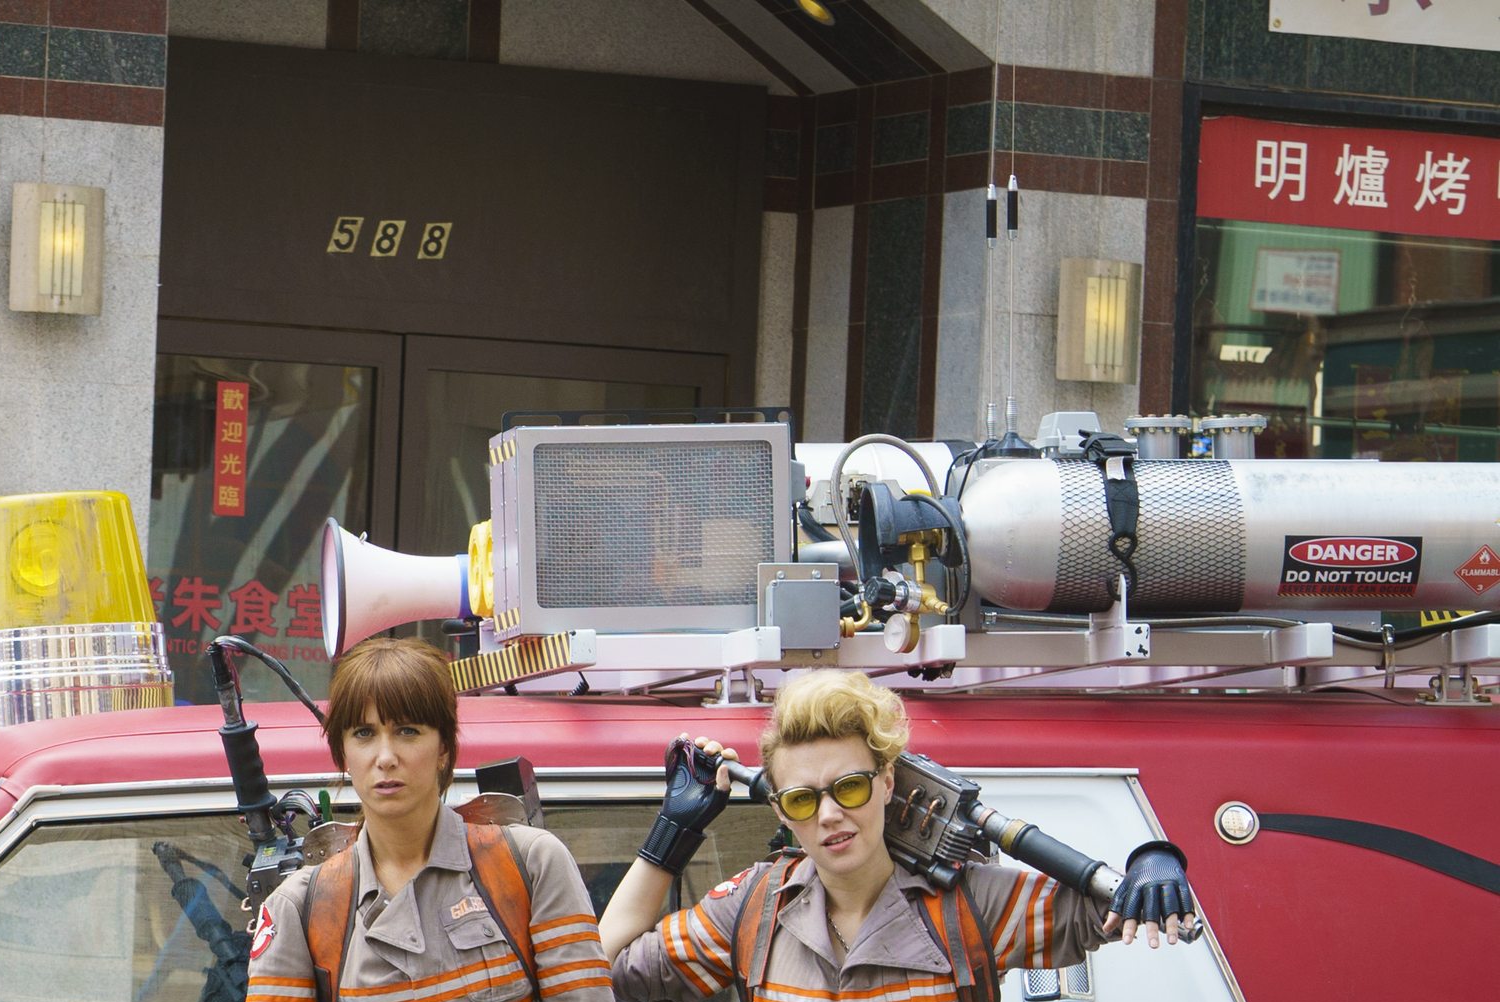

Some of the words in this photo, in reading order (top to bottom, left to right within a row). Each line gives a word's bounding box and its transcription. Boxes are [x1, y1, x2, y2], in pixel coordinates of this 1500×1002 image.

[1255, 140, 1500, 216] 明爐烤
[218, 388, 245, 507] 歡迎光臨
[1307, 544, 1399, 561] DANGER
[1285, 570, 1311, 583] DO
[1314, 570, 1352, 583] NOT
[1354, 571, 1413, 583] TOUCH
[1460, 569, 1500, 577] FLAMMABL
[1281, 584, 1319, 593] SEVERE
[1320, 584, 1354, 593] BURNS
[1356, 585, 1378, 593] CAN
[1379, 585, 1413, 593] OCCUR
[148, 577, 326, 639] 朱食堂
[293, 645, 339, 664] FOO
[450, 896, 489, 920] GILB
